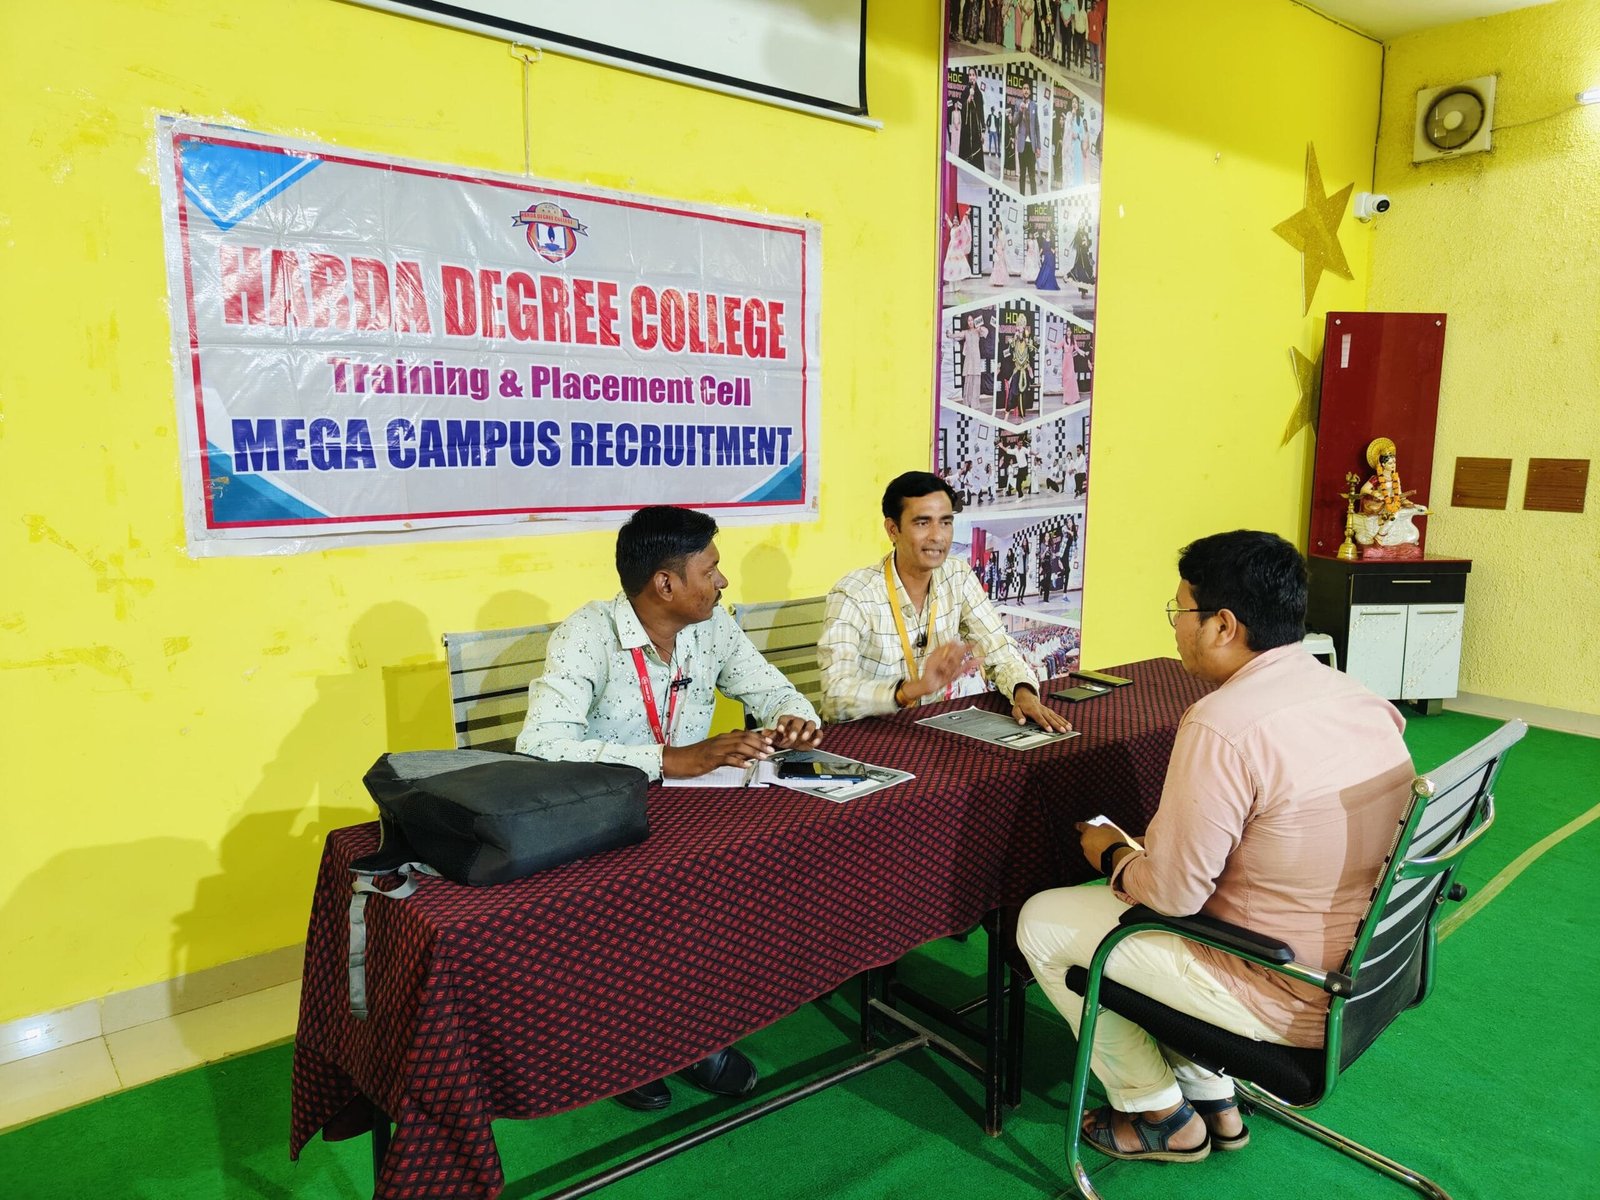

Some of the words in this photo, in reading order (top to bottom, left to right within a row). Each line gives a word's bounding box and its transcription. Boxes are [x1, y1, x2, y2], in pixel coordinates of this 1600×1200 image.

[948, 72, 963, 83] HDC
[220, 245, 432, 335] HARDA
[441, 265, 621, 346] DEGREE
[631, 285, 786, 360] COLLEGE
[327, 356, 490, 401] Training
[499, 369, 524, 398] &
[531, 366, 695, 404] Placement
[700, 375, 752, 406] Cell
[231, 418, 377, 472] MEGA
[386, 418, 562, 469] CAMPUS
[571, 421, 793, 468] RECRUITMENT
